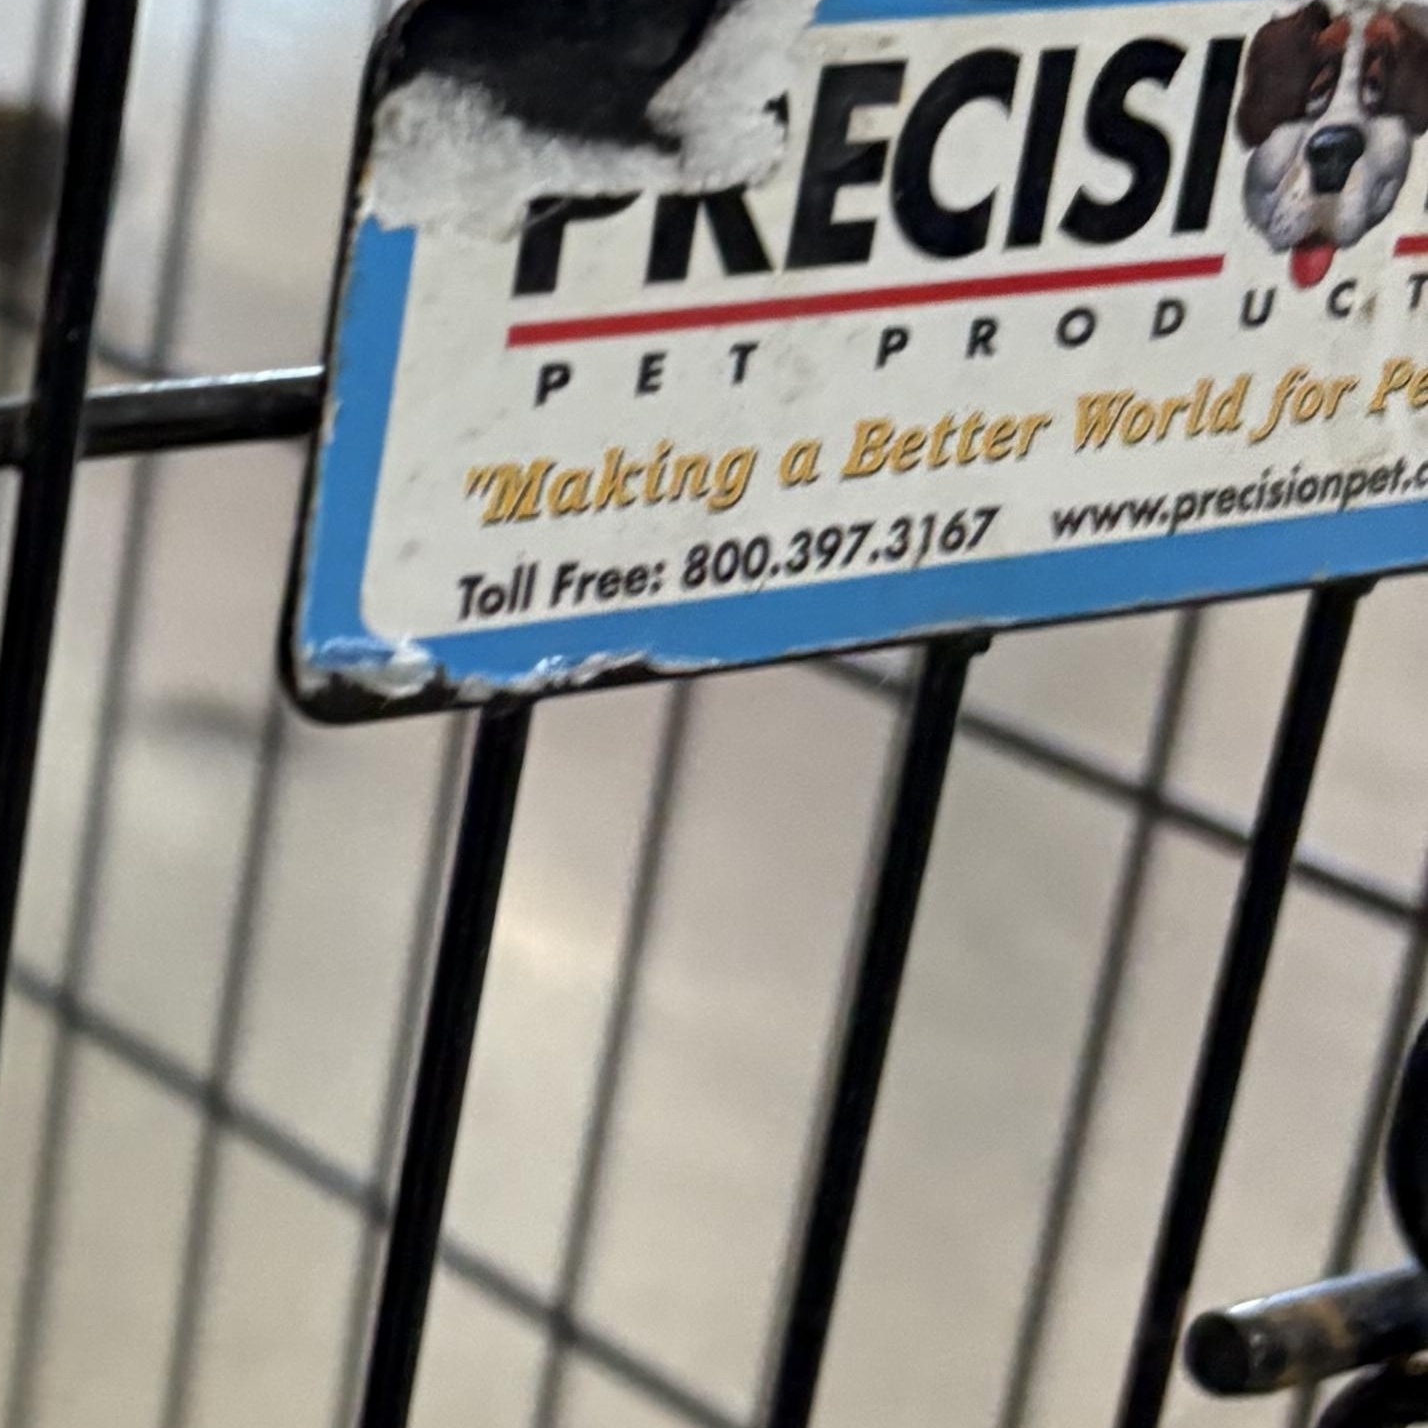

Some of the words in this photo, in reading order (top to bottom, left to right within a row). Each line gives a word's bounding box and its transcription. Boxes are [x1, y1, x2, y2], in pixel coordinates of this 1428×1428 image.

[535, 342, 757, 408] PET
[461, 439, 758, 525] "Making
[779, 439, 824, 488] a
[839, 406, 1052, 481] Better
[1073, 373, 1252, 453] World
[1248, 364, 1360, 446] for
[457, 560, 541, 620] Toll
[549, 557, 666, 608] Free:
[683, 505, 1002, 589] 800.397.3167
